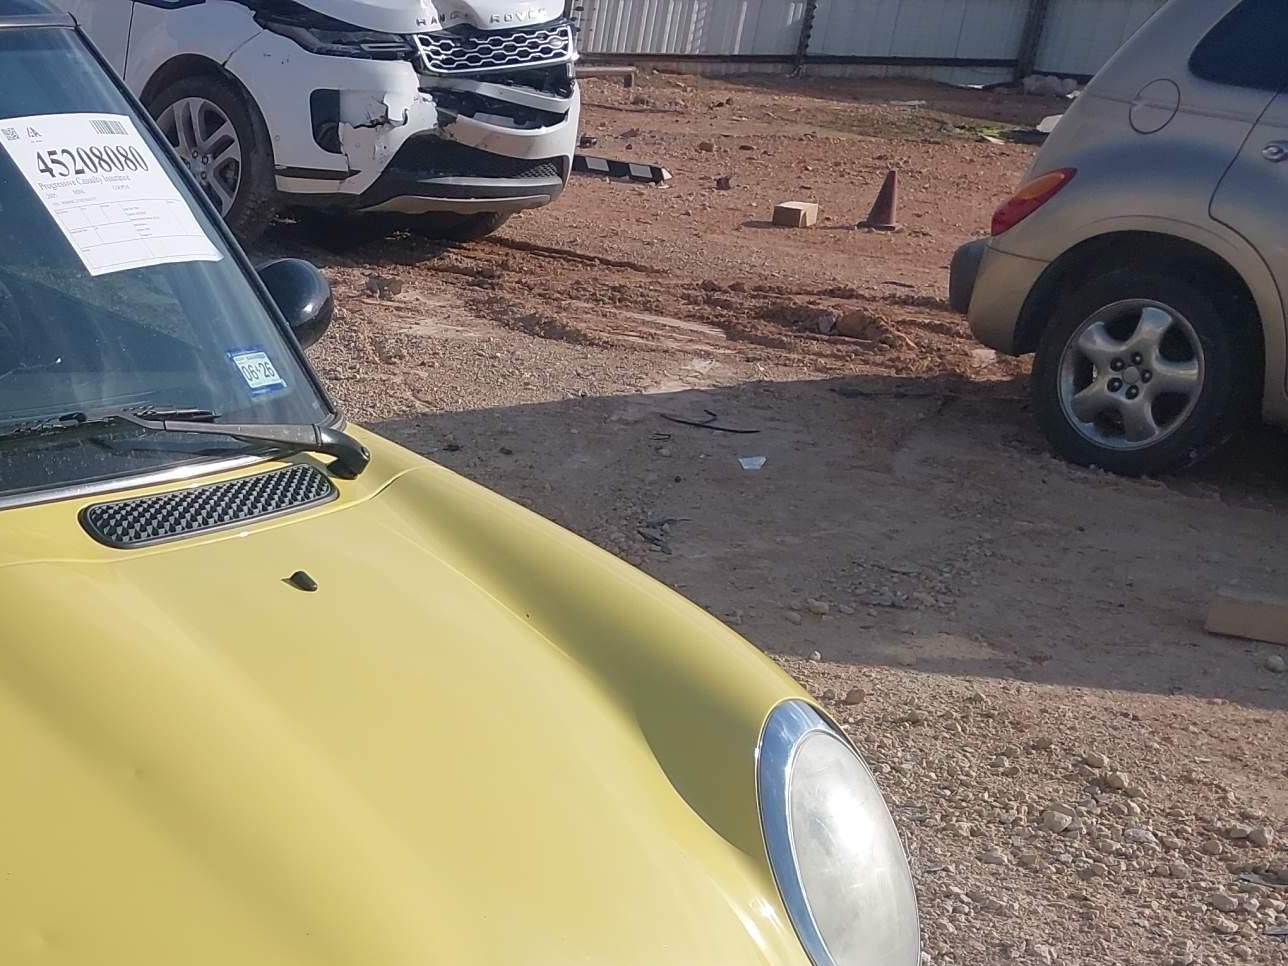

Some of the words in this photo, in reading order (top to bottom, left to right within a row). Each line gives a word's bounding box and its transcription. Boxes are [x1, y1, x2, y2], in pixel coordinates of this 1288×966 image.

[489, 8, 547, 24] ROVER
[36, 145, 149, 178] 45208080
[38, 179, 76, 191] Progressive
